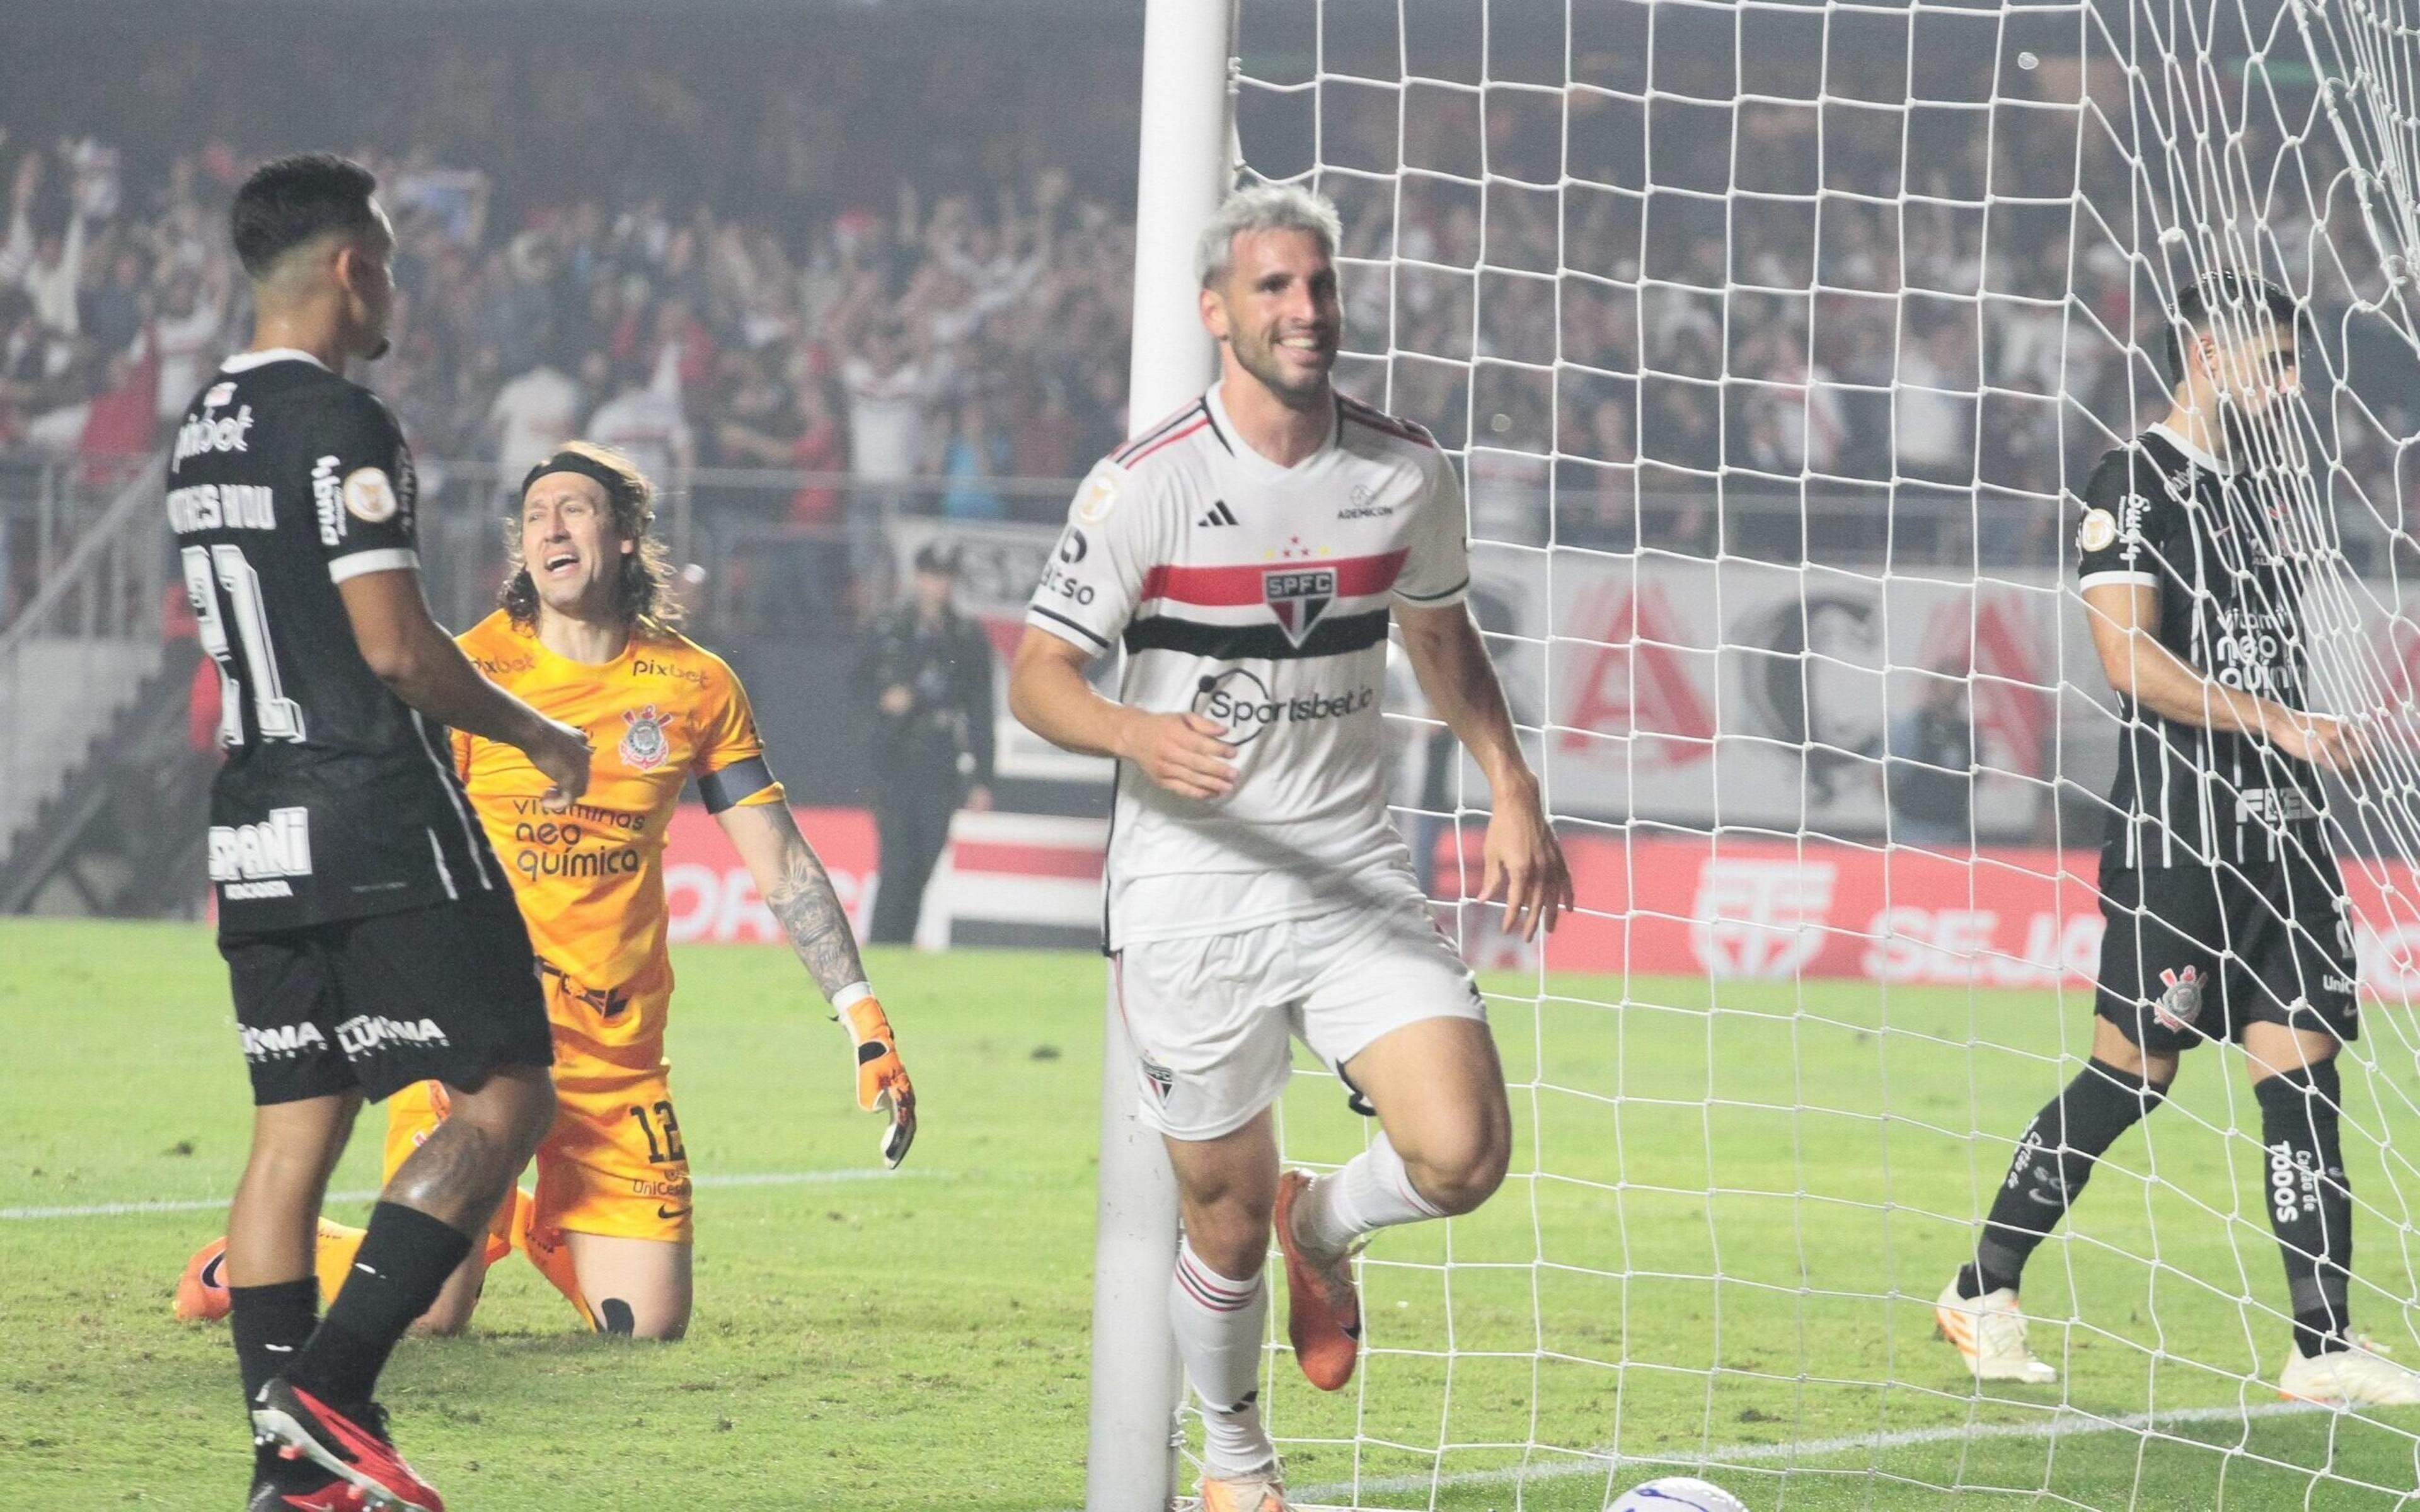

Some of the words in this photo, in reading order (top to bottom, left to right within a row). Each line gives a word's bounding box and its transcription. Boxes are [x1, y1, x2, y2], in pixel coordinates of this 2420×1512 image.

[1337, 506, 1393, 519] ADEMICON
[1269, 574, 1331, 595] SPFC
[2216, 634, 2278, 662] neo
[632, 659, 710, 690] pixbet
[516, 822, 582, 845] neo
[517, 845, 638, 882] química
[1862, 906, 2107, 984] SEJA
[630, 1099, 686, 1165] 12
[2269, 1140, 2299, 1223] TODOS
